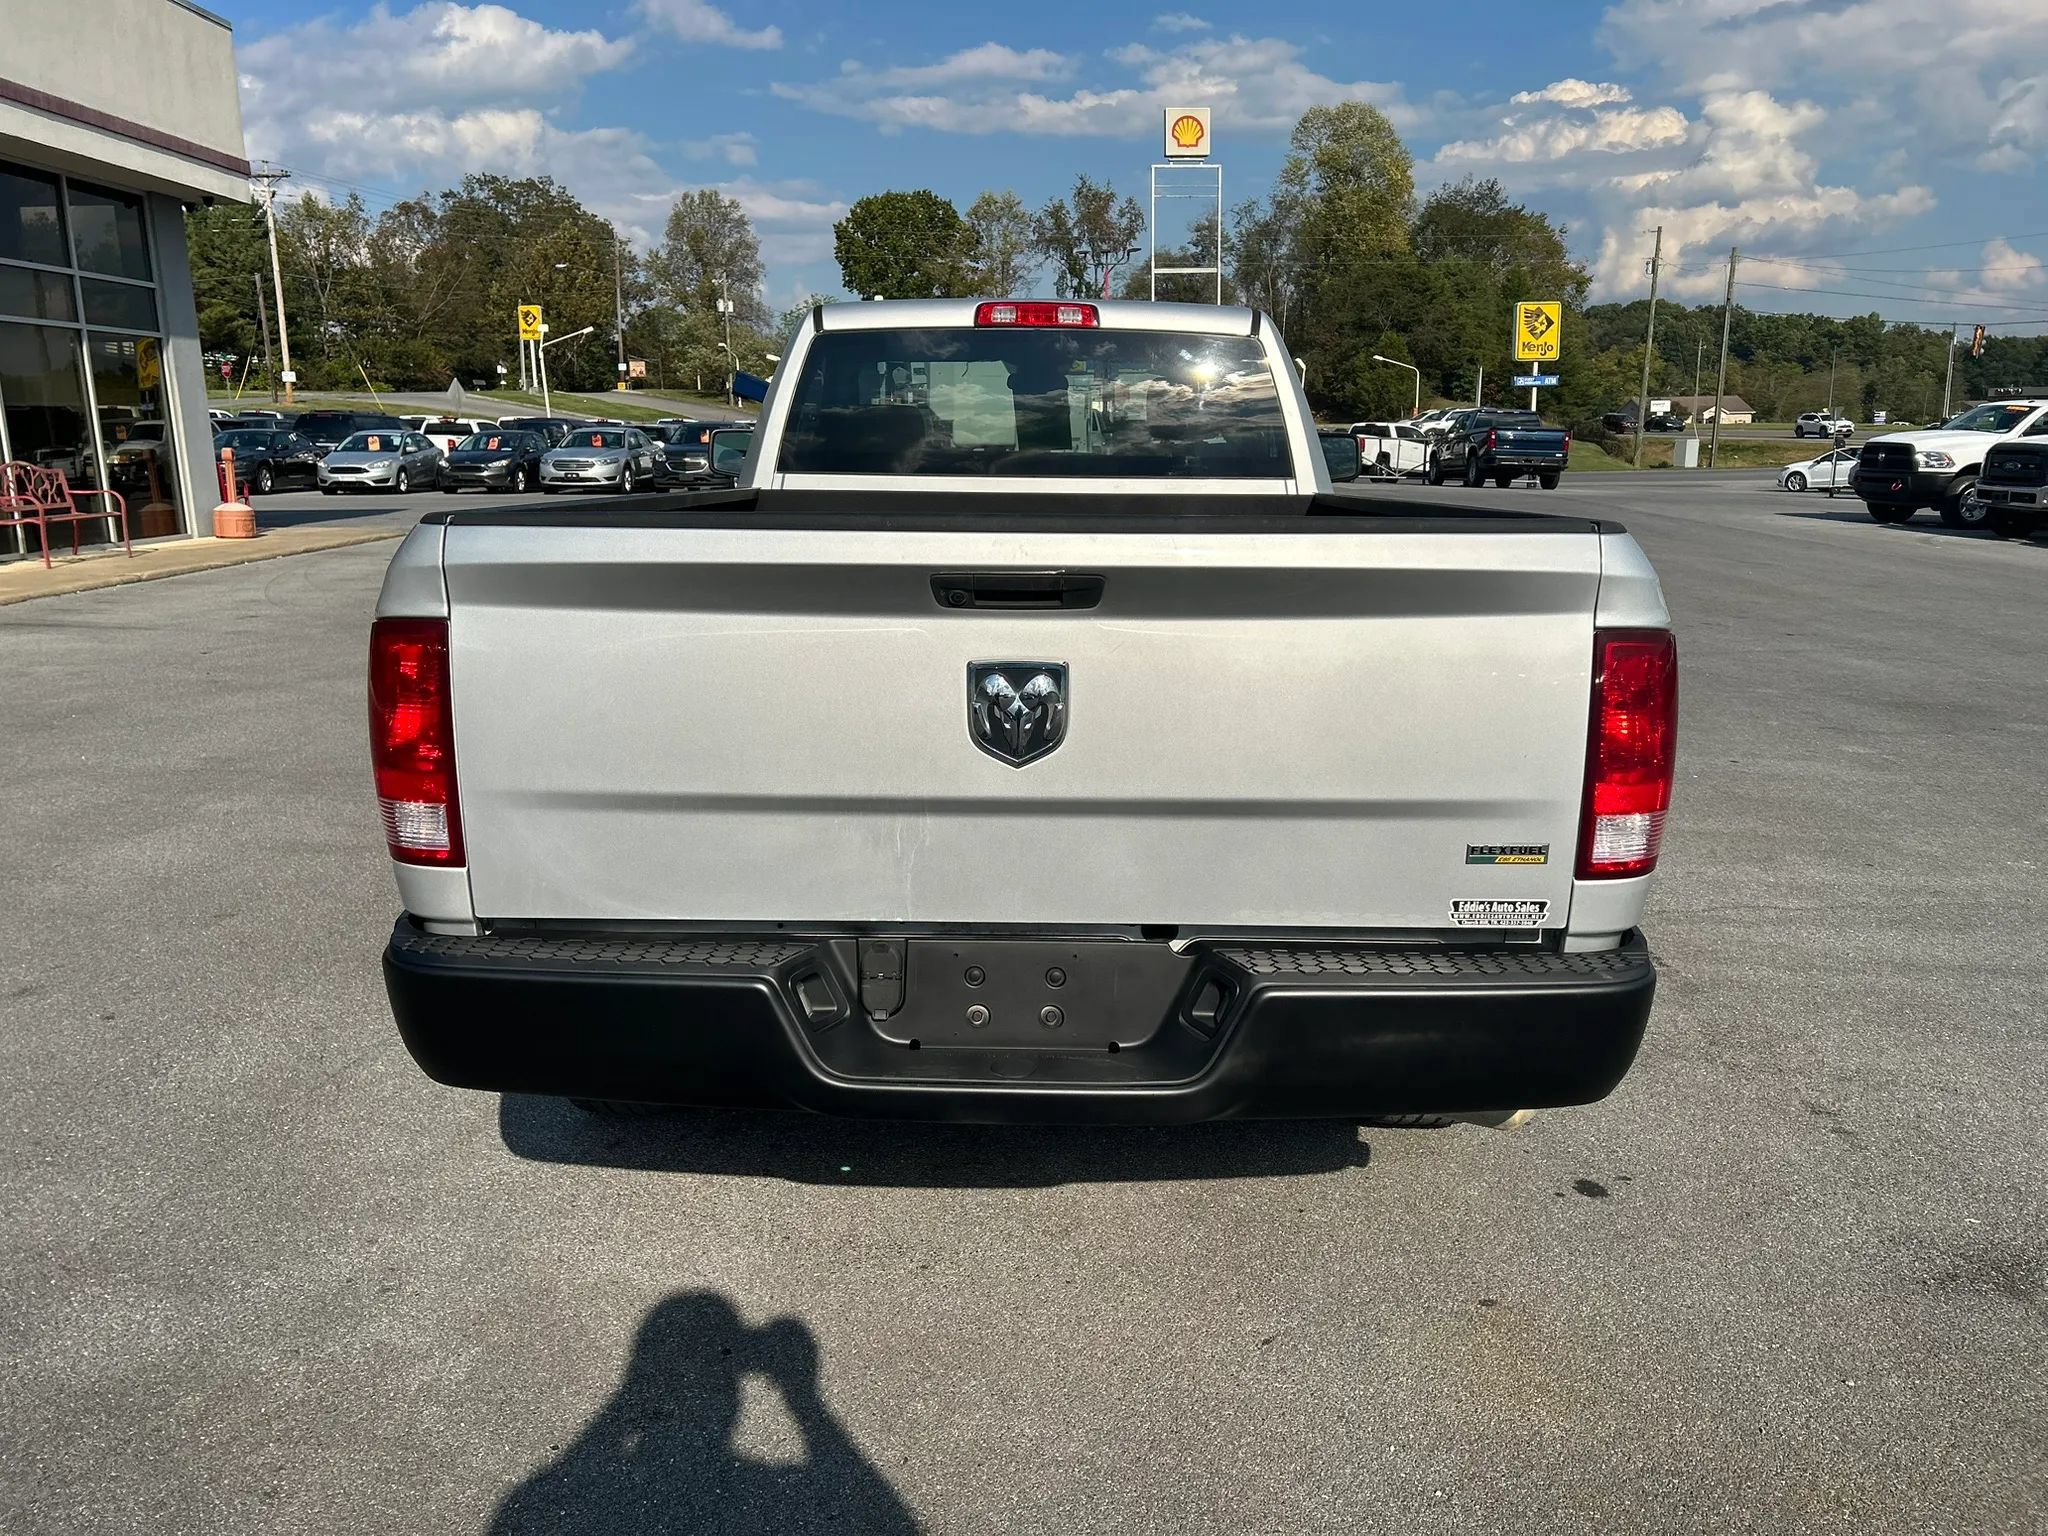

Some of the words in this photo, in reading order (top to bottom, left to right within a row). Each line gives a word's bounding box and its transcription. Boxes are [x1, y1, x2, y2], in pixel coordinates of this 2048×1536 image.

[1458, 901, 1491, 912] Eddie's
[1491, 902, 1514, 912] Auto
[1515, 902, 1540, 912] Sales
